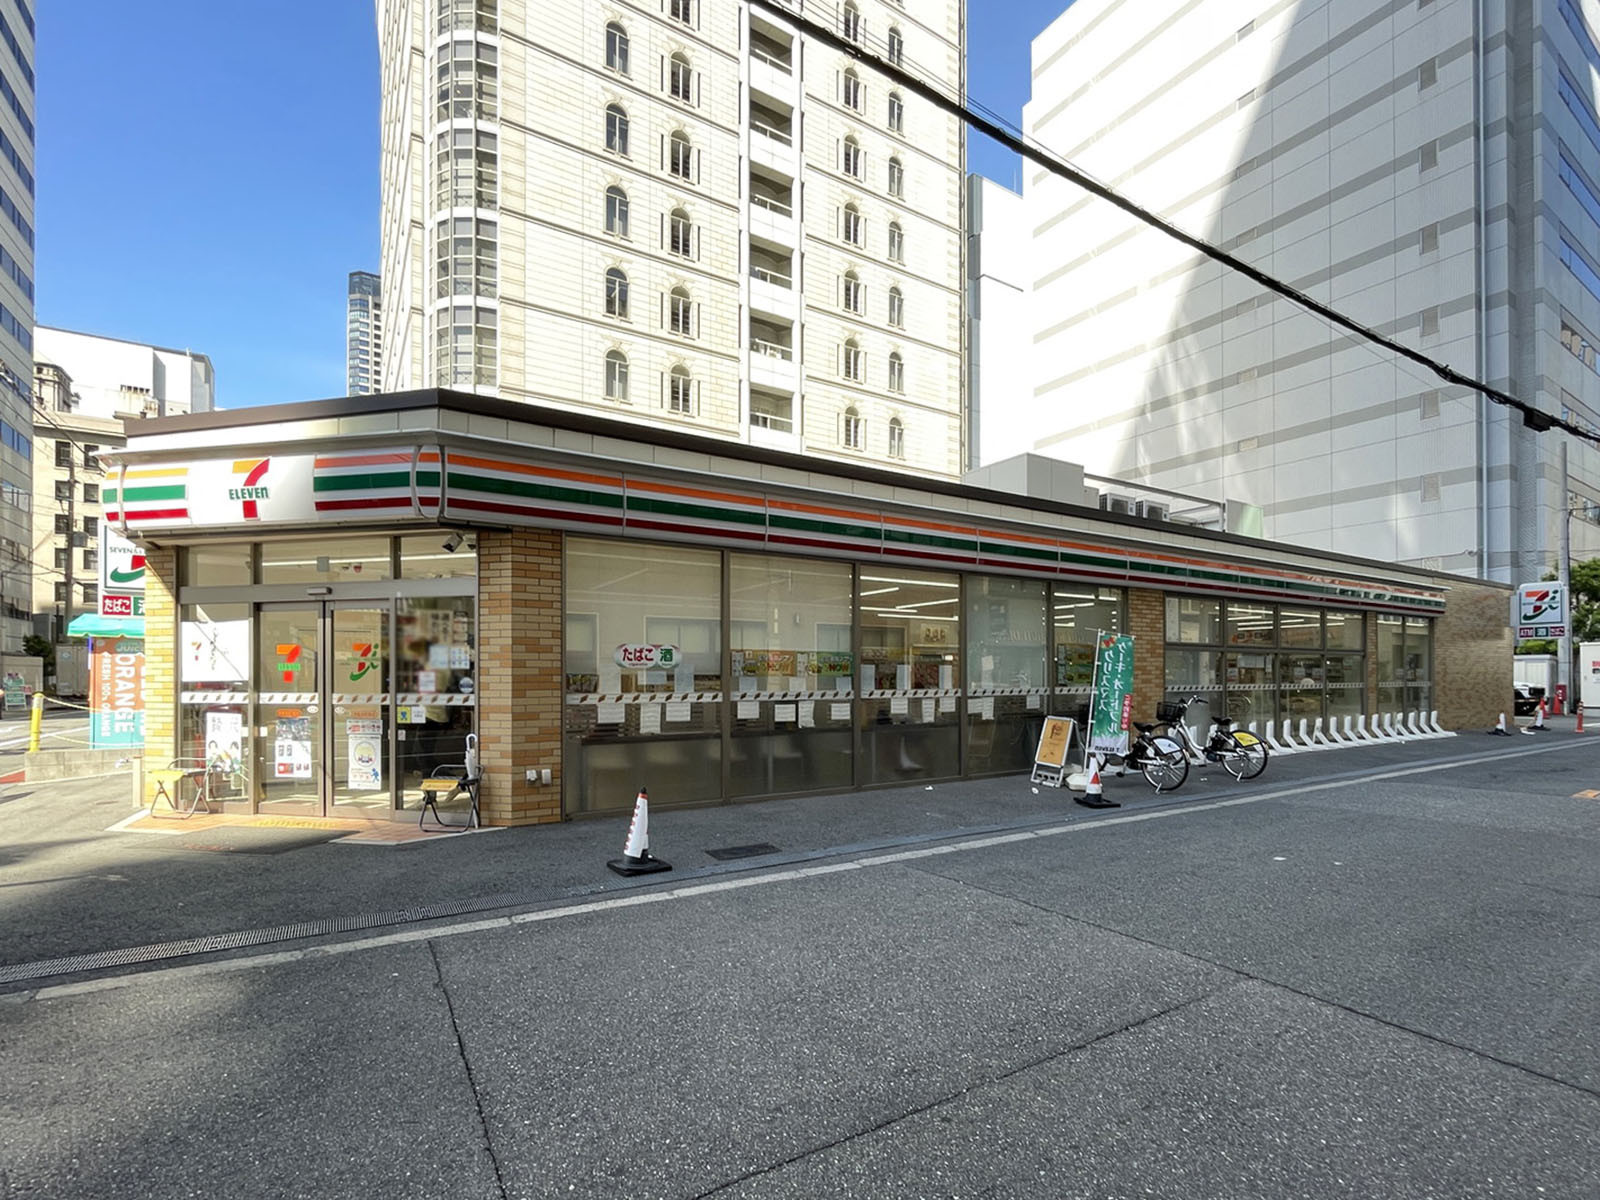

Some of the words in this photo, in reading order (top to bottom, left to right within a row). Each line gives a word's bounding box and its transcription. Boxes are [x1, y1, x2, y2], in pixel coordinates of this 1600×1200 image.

[104, 598, 131, 613] たばこ
[622, 648, 654, 661] たばこ
[660, 648, 673, 662] 酒
[115, 653, 136, 733] ORANGE
